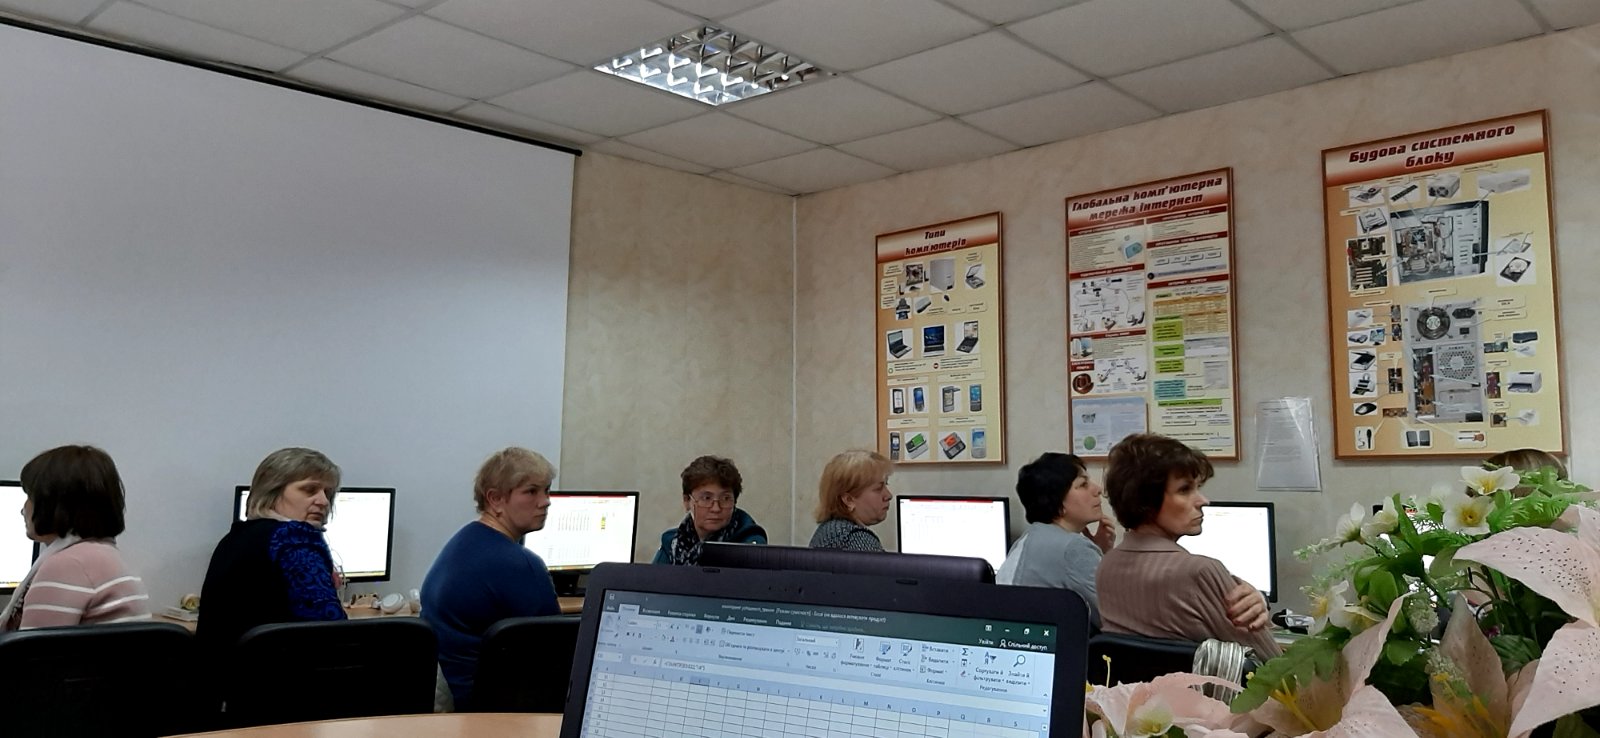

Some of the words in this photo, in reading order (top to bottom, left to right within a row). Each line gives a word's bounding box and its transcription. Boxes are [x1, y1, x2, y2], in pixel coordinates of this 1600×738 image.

[1349, 145, 1406, 163] Будова
[1411, 126, 1515, 151] системного
[1406, 151, 1454, 167] блоку
[1072, 195, 1129, 212] Глобальна
[1133, 178, 1222, 201] комп'ютерна
[1090, 206, 1135, 221] мережа
[1140, 194, 1203, 211] інтернет
[925, 230, 946, 239] Типи
[1008, 641, 1030, 649] Спільний
